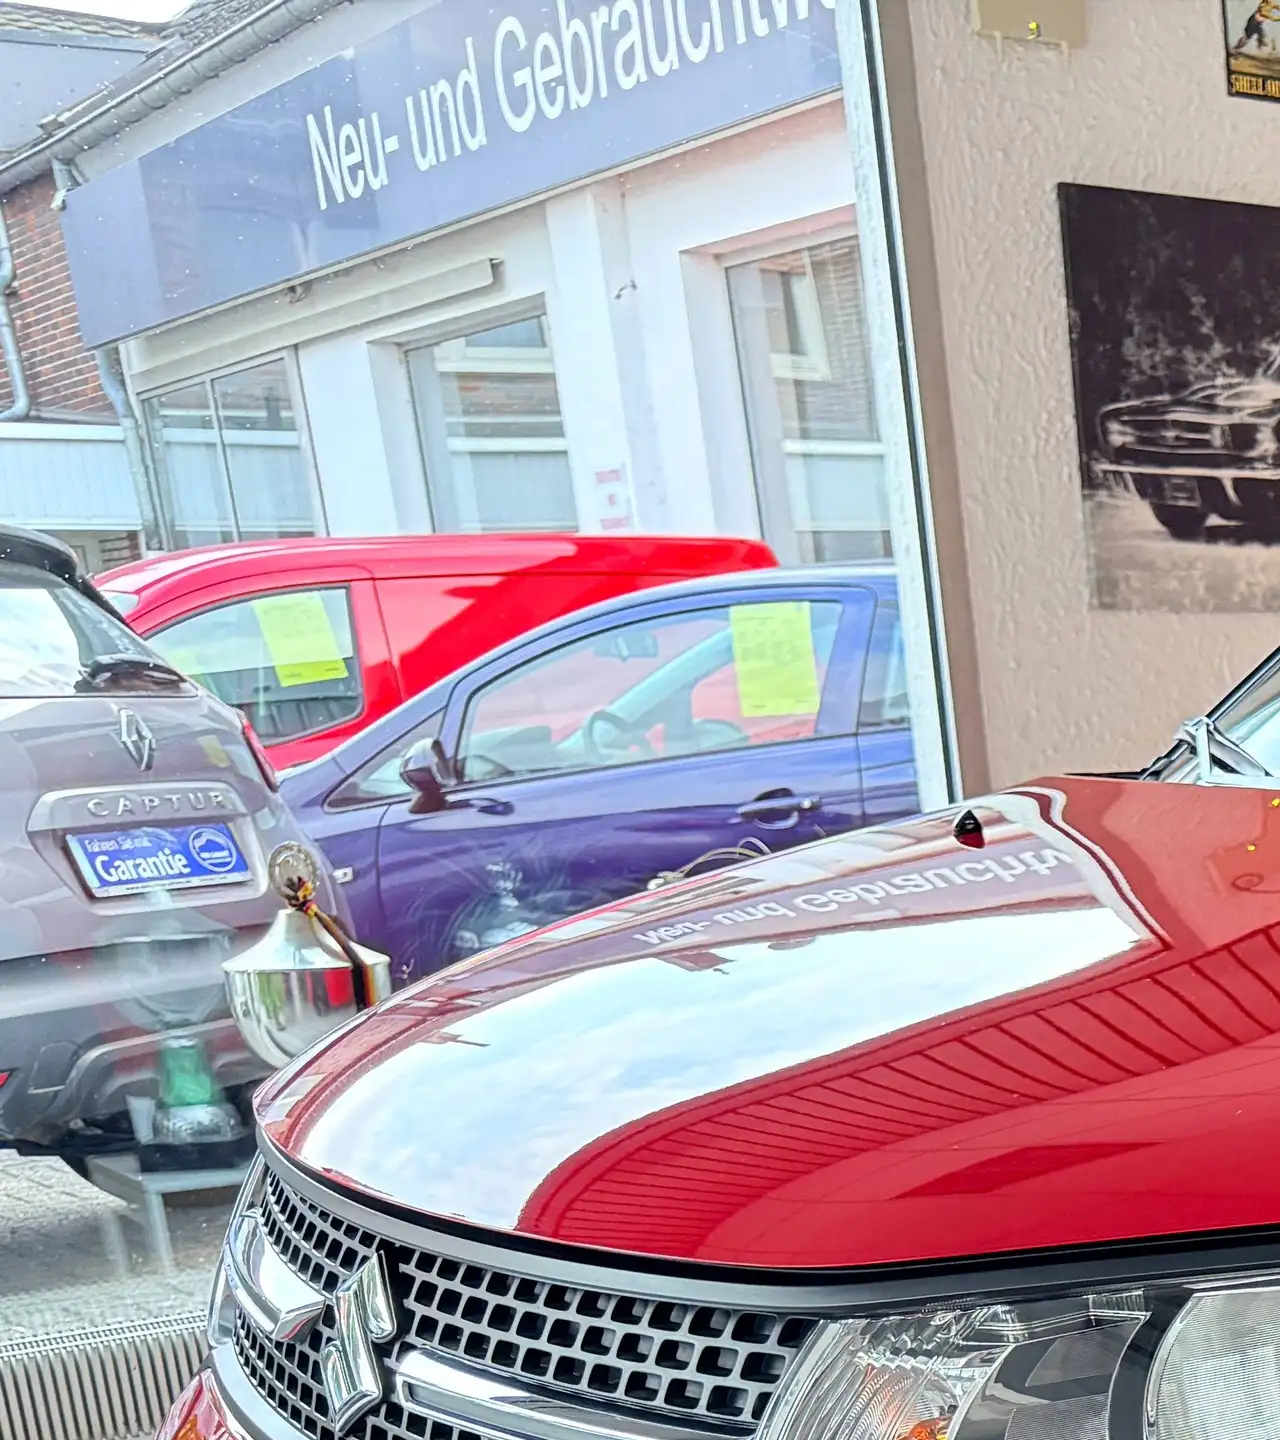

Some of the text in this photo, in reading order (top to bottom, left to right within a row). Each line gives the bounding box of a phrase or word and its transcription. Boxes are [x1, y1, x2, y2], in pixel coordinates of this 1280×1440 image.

[306, 0, 836, 210] Neu- und Gebrauc
[87, 791, 233, 817] CAPTUR
[95, 847, 192, 883] Garantie
